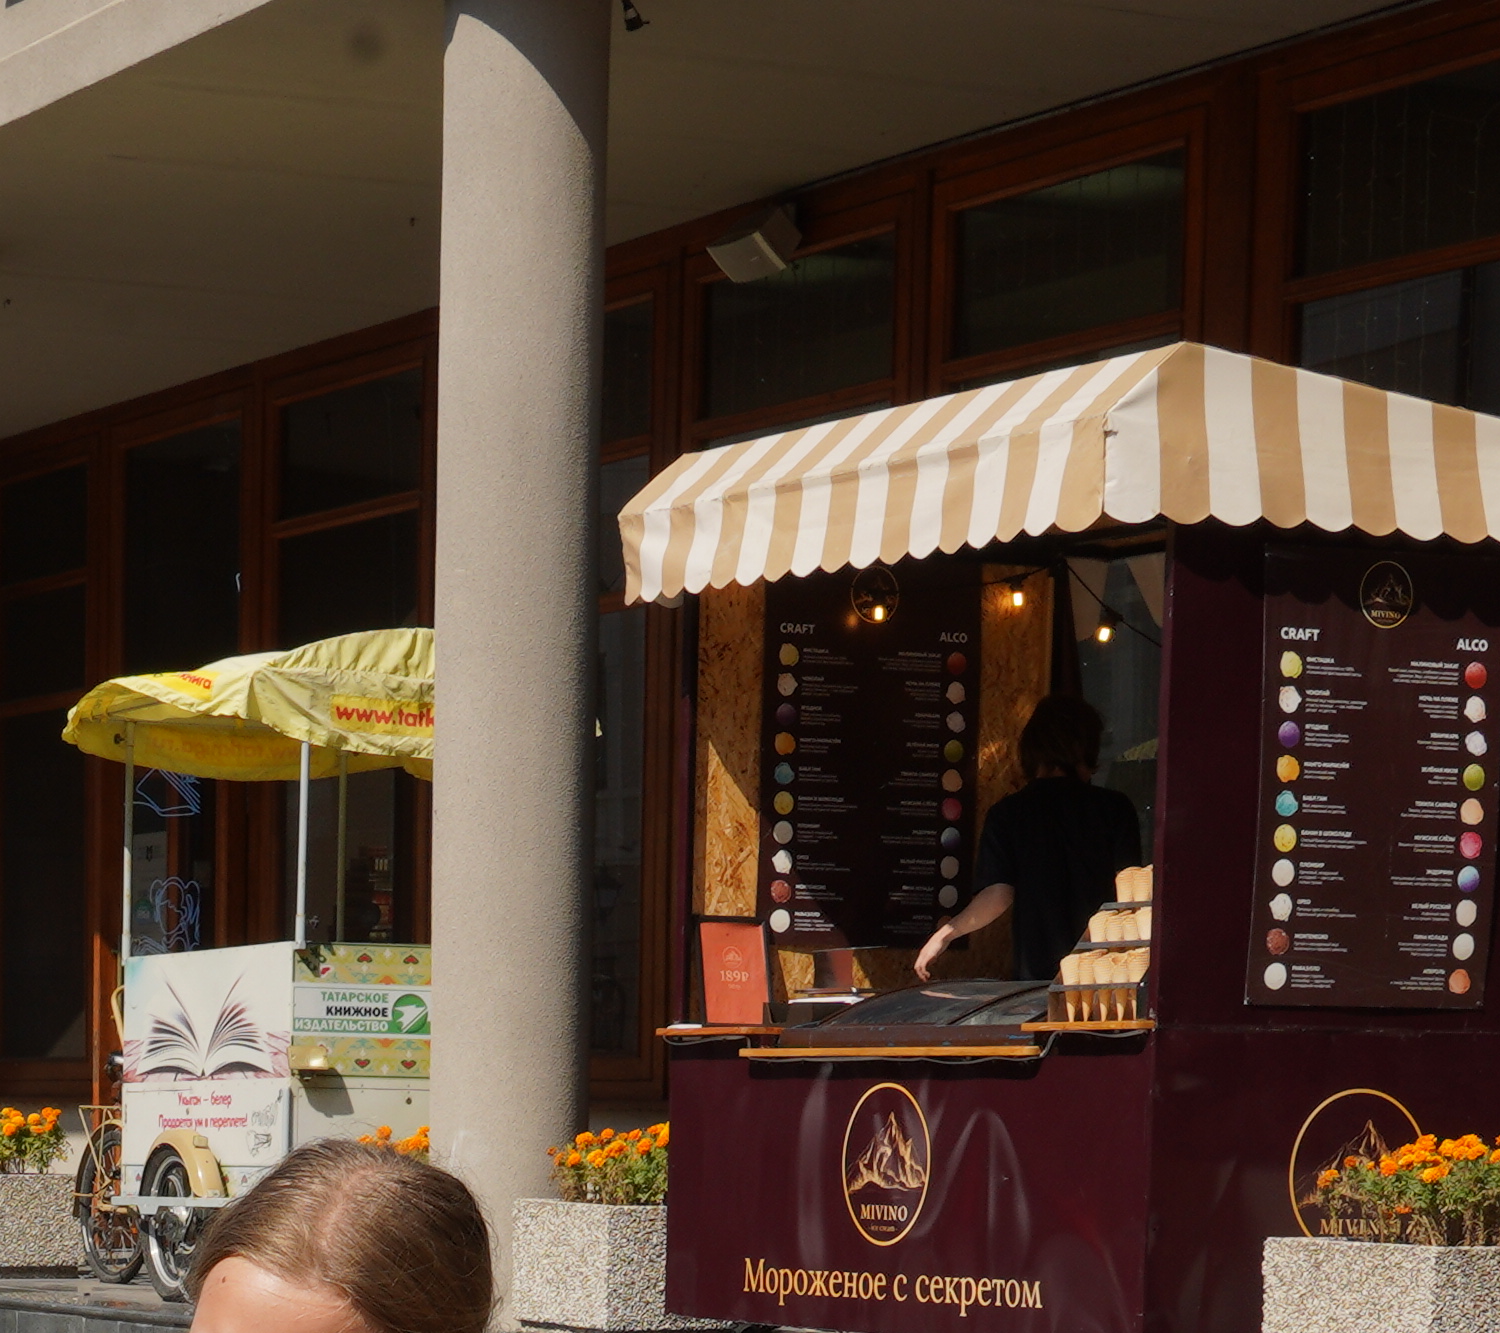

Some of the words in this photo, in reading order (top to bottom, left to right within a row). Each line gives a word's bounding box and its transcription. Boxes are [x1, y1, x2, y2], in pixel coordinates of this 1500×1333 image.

[779, 622, 815, 635] CRAFT
[1280, 626, 1320, 641] CRAFT
[939, 631, 968, 644] ALCO
[1456, 638, 1489, 652] ALCO
[335, 705, 435, 728] www.tatk
[321, 990, 389, 1004] ТАТАРСКОЕ
[326, 1005, 389, 1018] КНИЖНОЕ
[294, 1018, 389, 1032] ИЗДАТЕЛЬСТВО
[860, 1203, 908, 1222] MIVINO
[1318, 1217, 1388, 1236] MIVIN
[742, 1257, 887, 1306] Мороженое
[893, 1272, 908, 1302] с
[915, 1273, 1044, 1318] секретом
